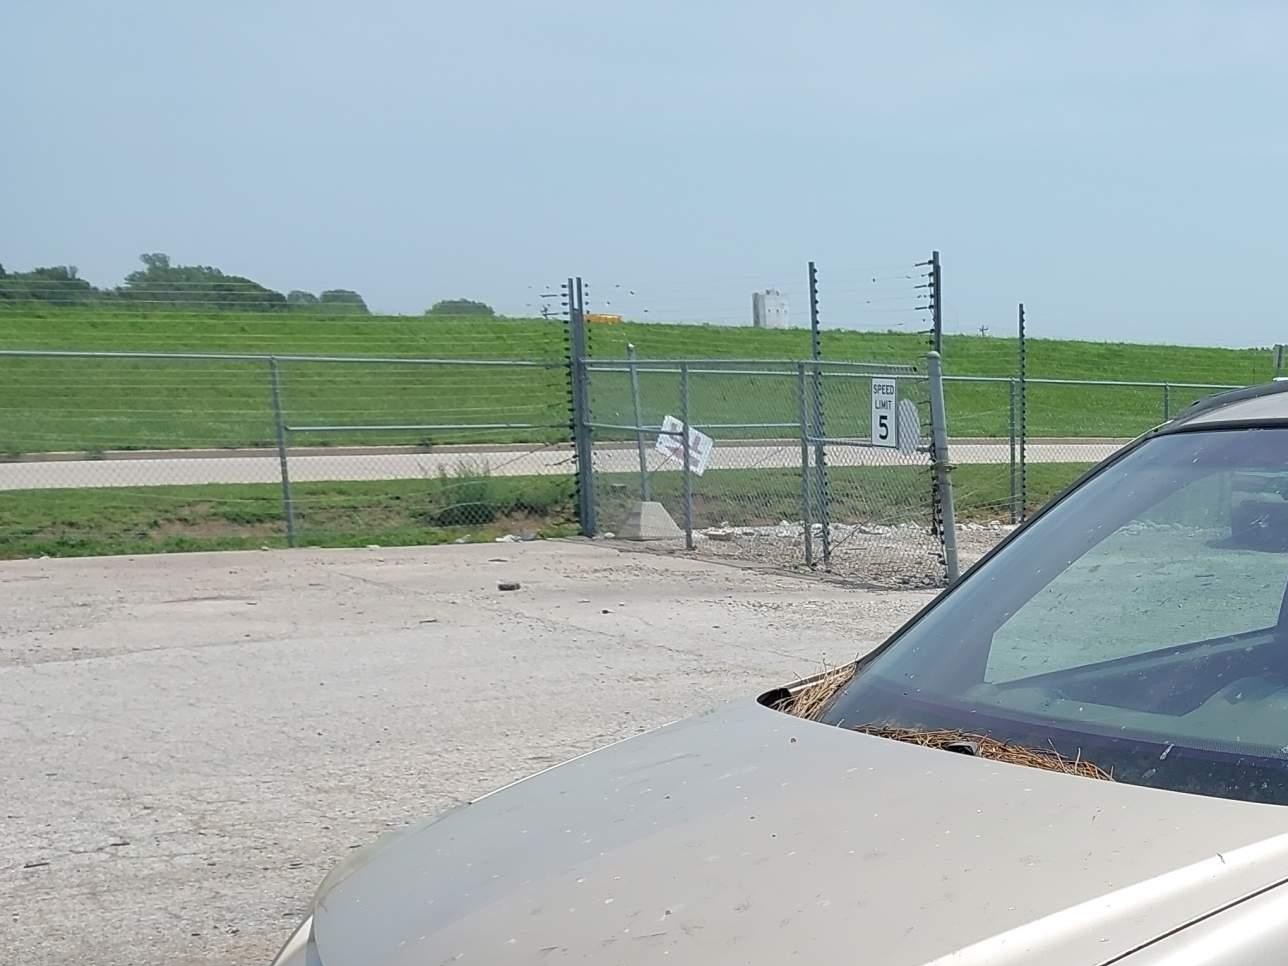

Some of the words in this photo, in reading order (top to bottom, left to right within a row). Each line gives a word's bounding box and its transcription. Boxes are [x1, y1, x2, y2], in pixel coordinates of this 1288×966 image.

[873, 384, 895, 395] SPEED
[875, 400, 892, 410] LIMIT
[879, 415, 889, 440] 5
